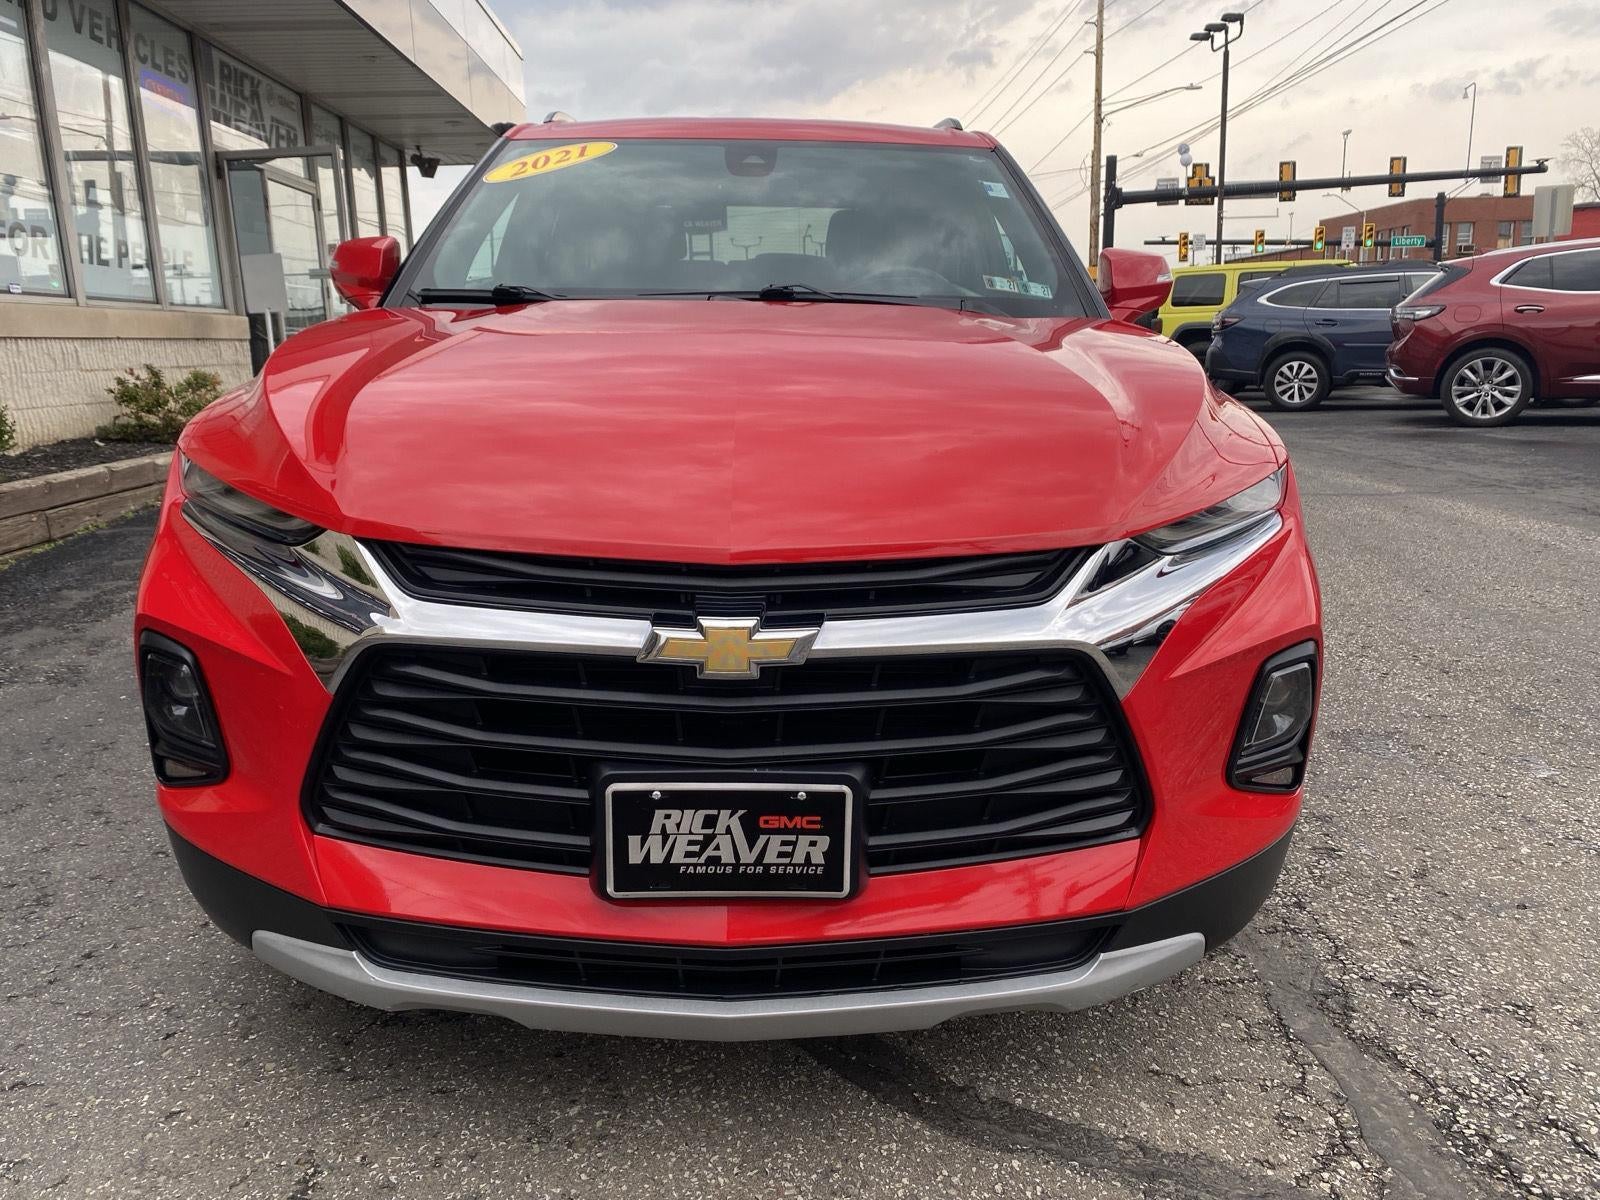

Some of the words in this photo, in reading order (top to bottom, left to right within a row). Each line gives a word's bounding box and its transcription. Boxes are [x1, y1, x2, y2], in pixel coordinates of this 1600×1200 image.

[219, 59, 264, 107] RICK
[510, 144, 588, 178] 2021
[1395, 237, 1422, 247] Liberty
[649, 809, 748, 835] RICK
[758, 815, 822, 829] GMC
[627, 834, 830, 865] WEAVER
[679, 866, 733, 875] FAMOUS
[739, 866, 763, 875] FOR
[769, 866, 825, 875] SERVICE
